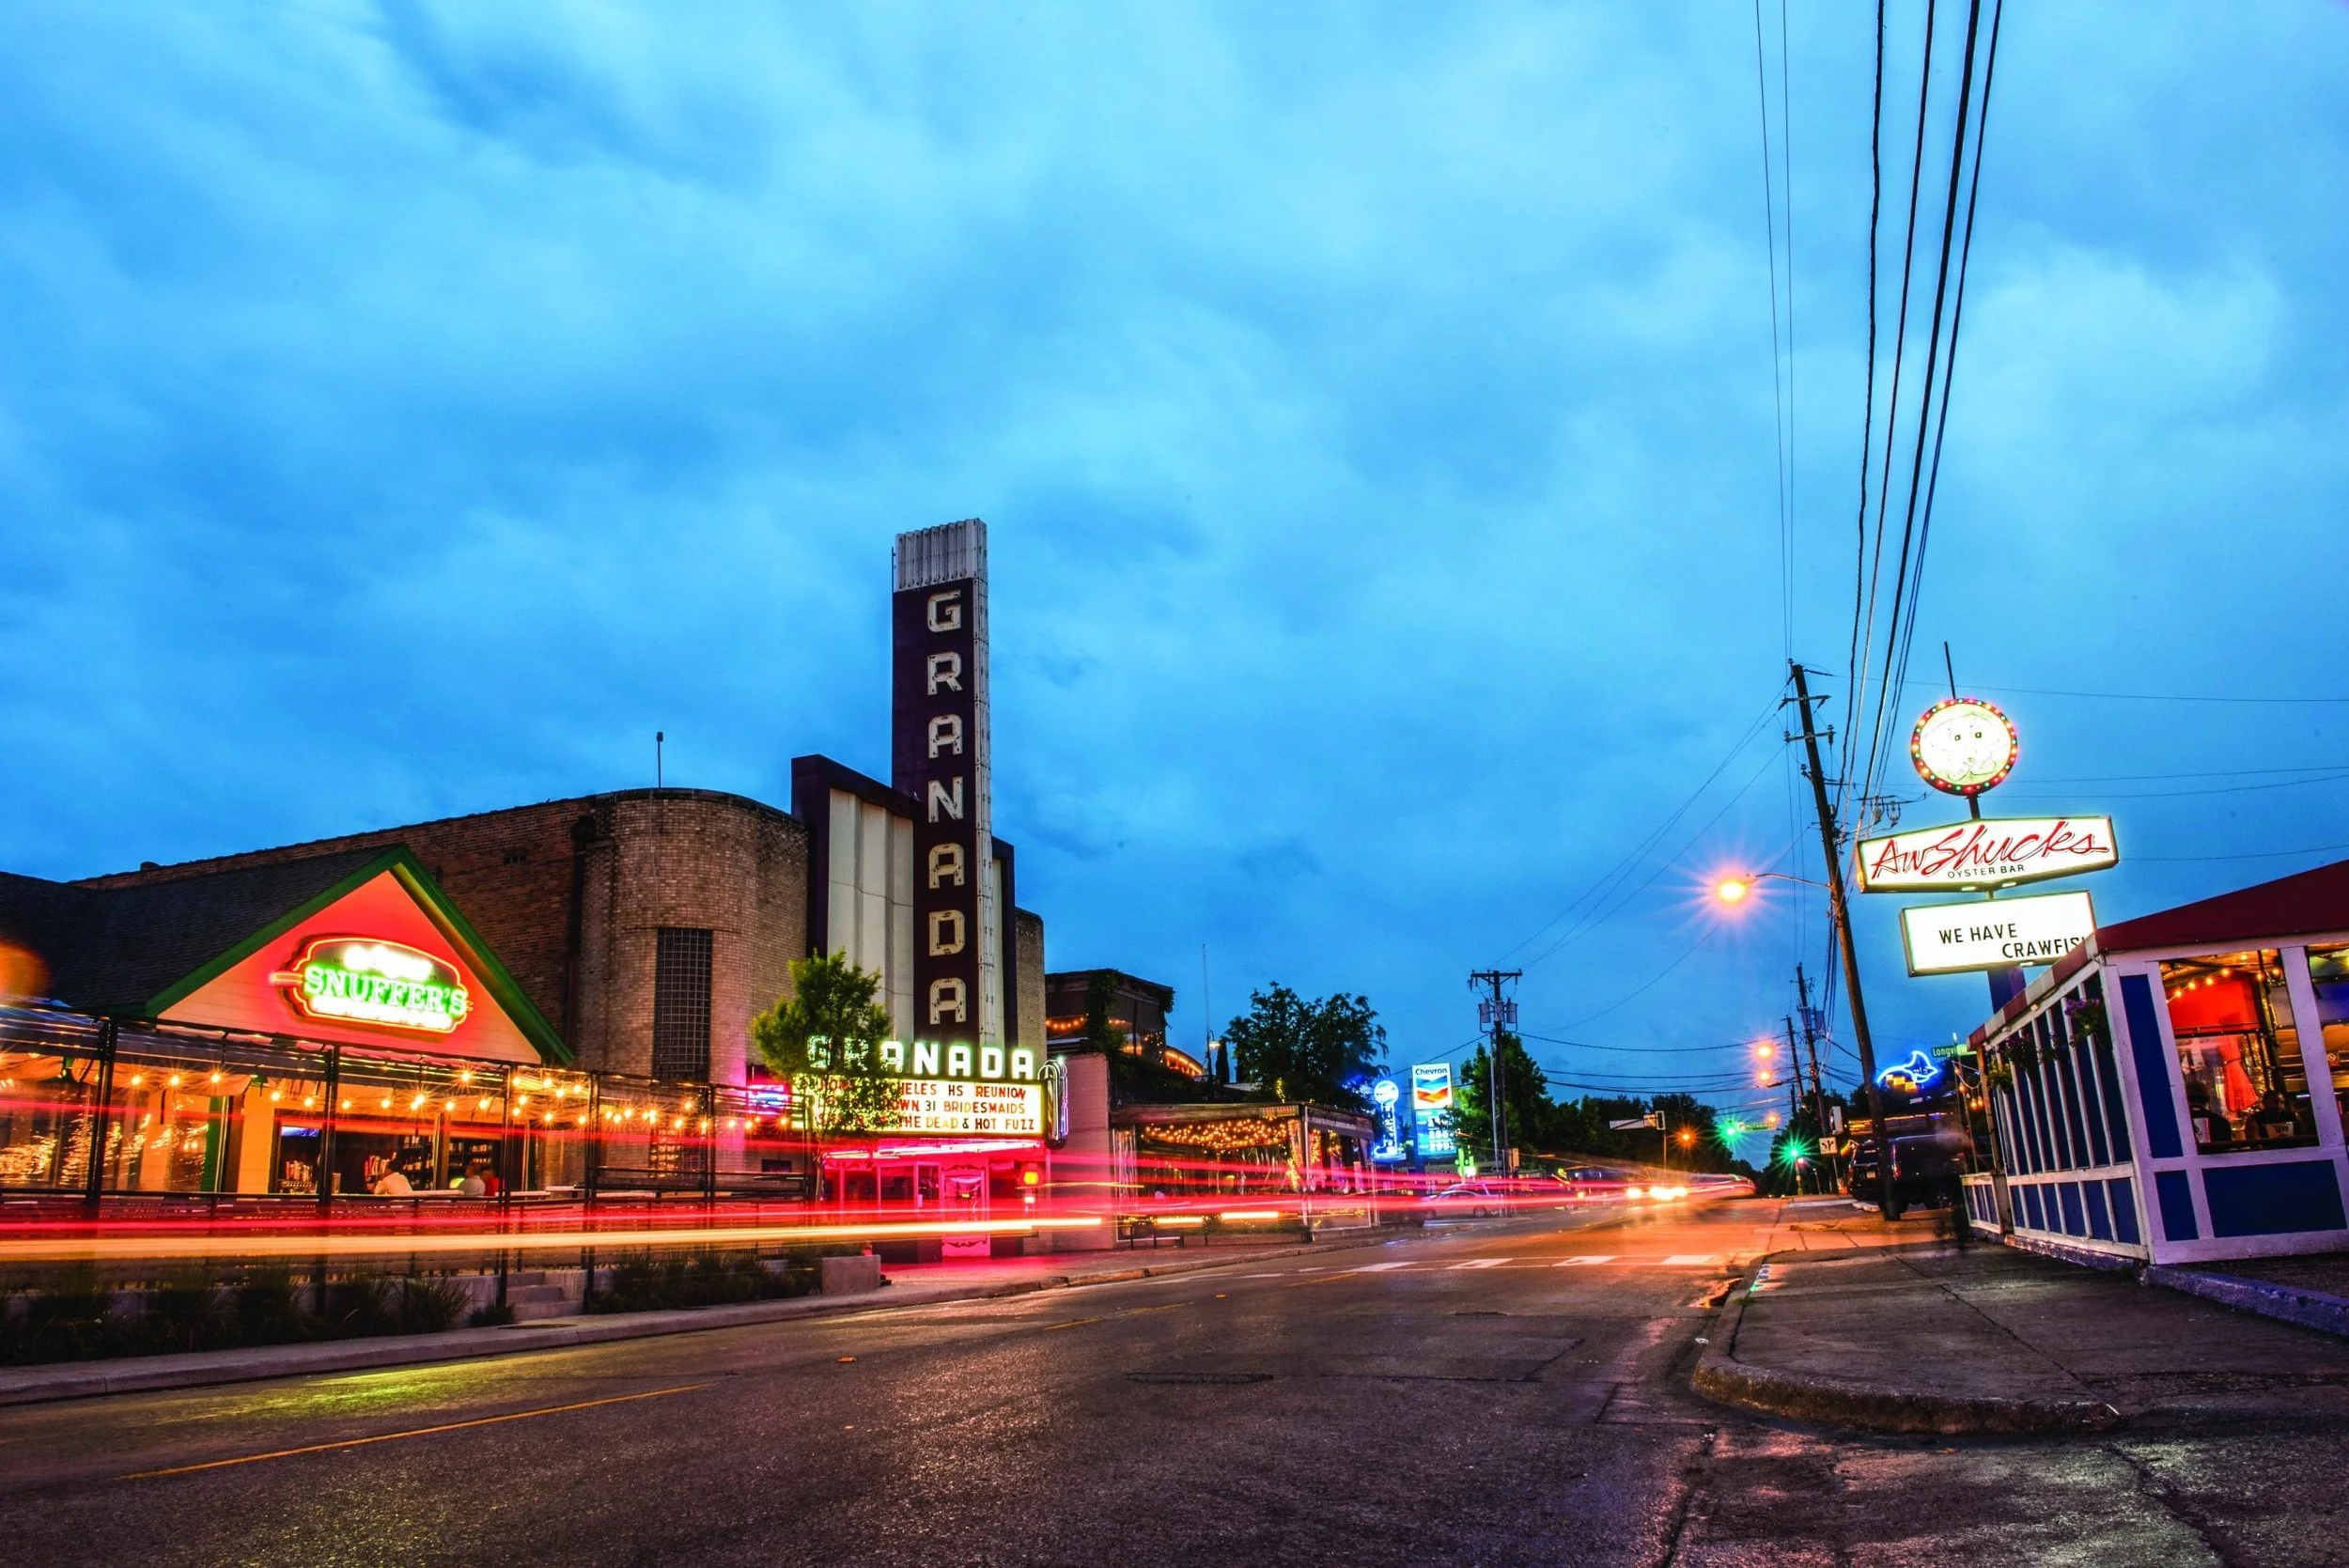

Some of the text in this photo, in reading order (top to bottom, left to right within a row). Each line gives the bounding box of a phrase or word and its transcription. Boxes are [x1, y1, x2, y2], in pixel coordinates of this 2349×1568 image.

[926, 588, 967, 1025] GRANADA
[1872, 820, 2108, 879] Aw Shucks
[1947, 863, 2025, 879] OYSTER BAR
[1938, 924, 2017, 944] WE HAVE
[2001, 937, 2085, 958] CRAWFIS
[303, 964, 469, 1017] SNUFFER'S
[807, 1035, 1034, 1079] GRANADA
[1415, 1067, 1448, 1076] Chevron
[948, 1084, 964, 1096] HS
[975, 1085, 1026, 1100] REUNION
[925, 1100, 936, 1112] 31
[943, 1100, 1025, 1114] BRIDESMAIDS
[926, 1116, 958, 1128] DEAD
[961, 1118, 970, 1129] &
[974, 1118, 998, 1130] HOT
[1005, 1118, 1034, 1130] FUZZ
